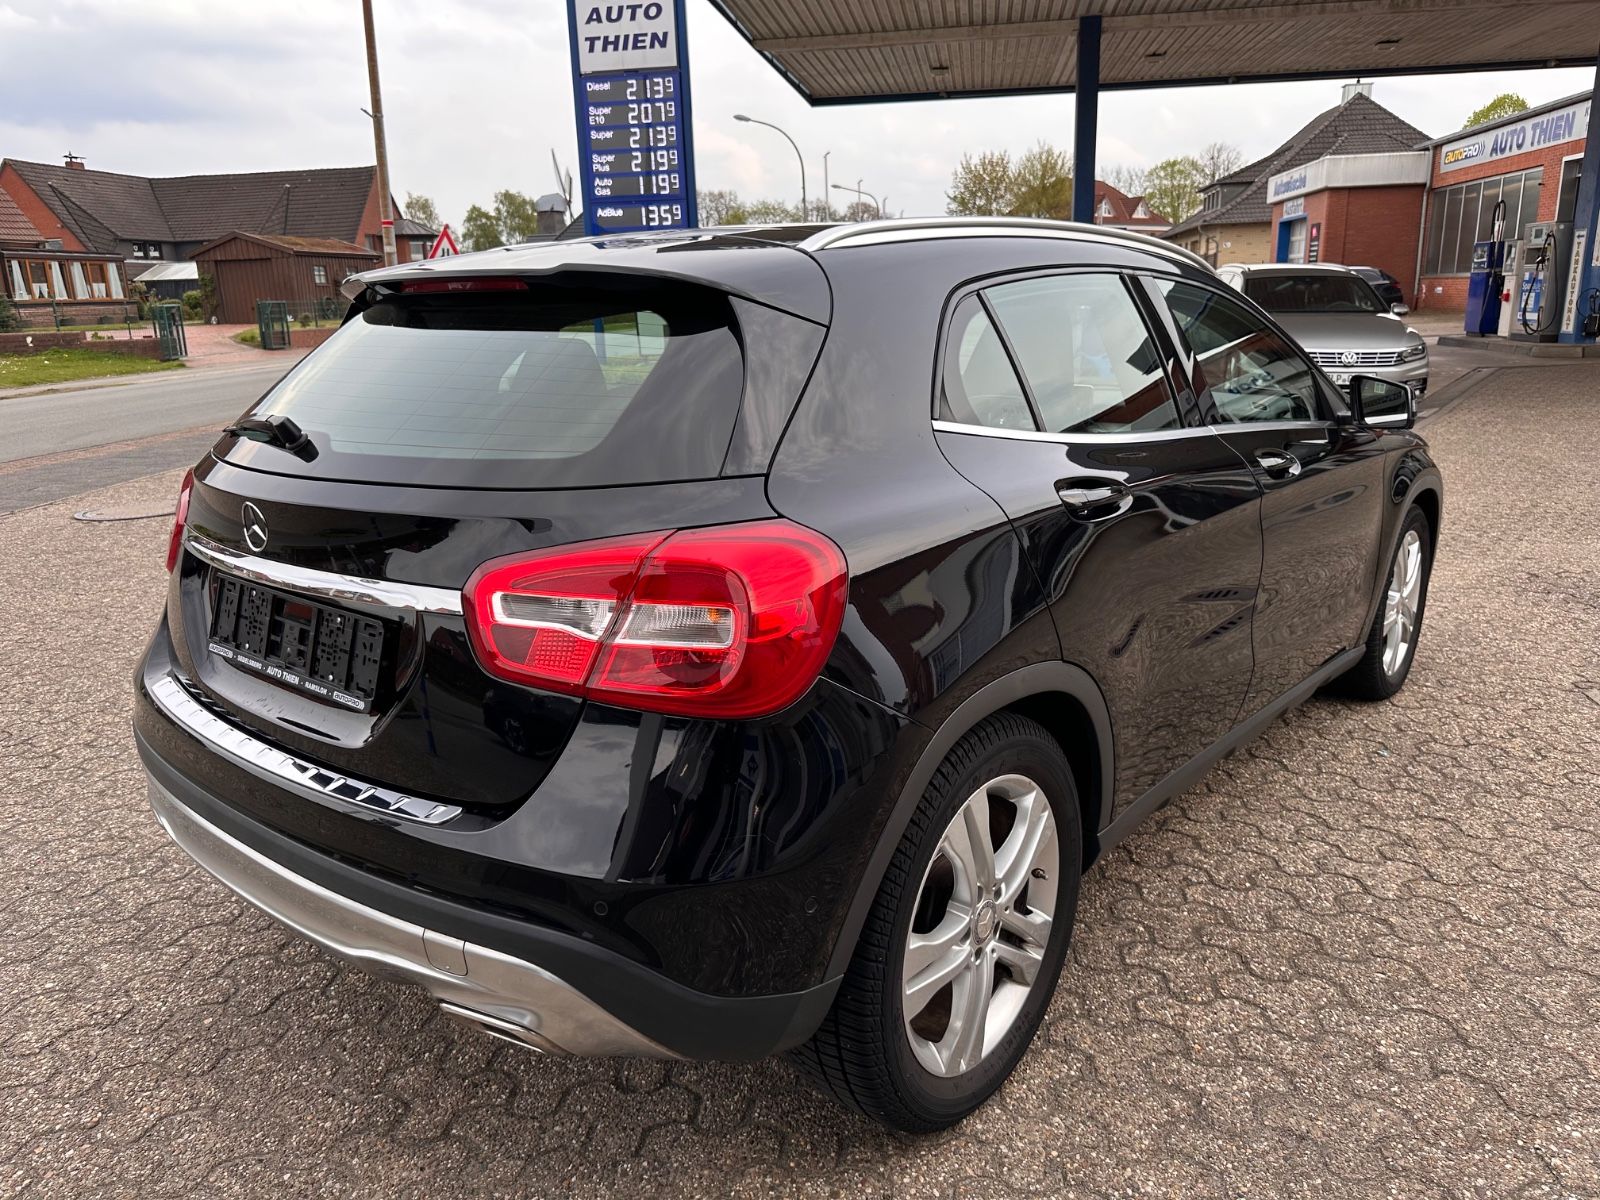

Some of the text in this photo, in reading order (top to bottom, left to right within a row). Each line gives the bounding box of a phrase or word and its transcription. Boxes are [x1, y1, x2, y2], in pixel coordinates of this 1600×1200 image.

[584, 2, 663, 25] AUTO
[584, 31, 669, 54] THIEN
[586, 82, 611, 92] Diesel
[588, 106, 612, 116] Super
[589, 116, 605, 125] E10
[590, 130, 614, 140] Super
[1489, 110, 1576, 158] AUTO THIEN
[592, 154, 616, 164] Super
[592, 163, 610, 173] Plus
[594, 177, 612, 187] Auto
[595, 187, 611, 196] Gas
[596, 207, 624, 218] AdBlue
[1564, 241, 1583, 330] TANKAUTOMAT
[266, 666, 282, 678] AUTO
[282, 671, 300, 685] THIEN
